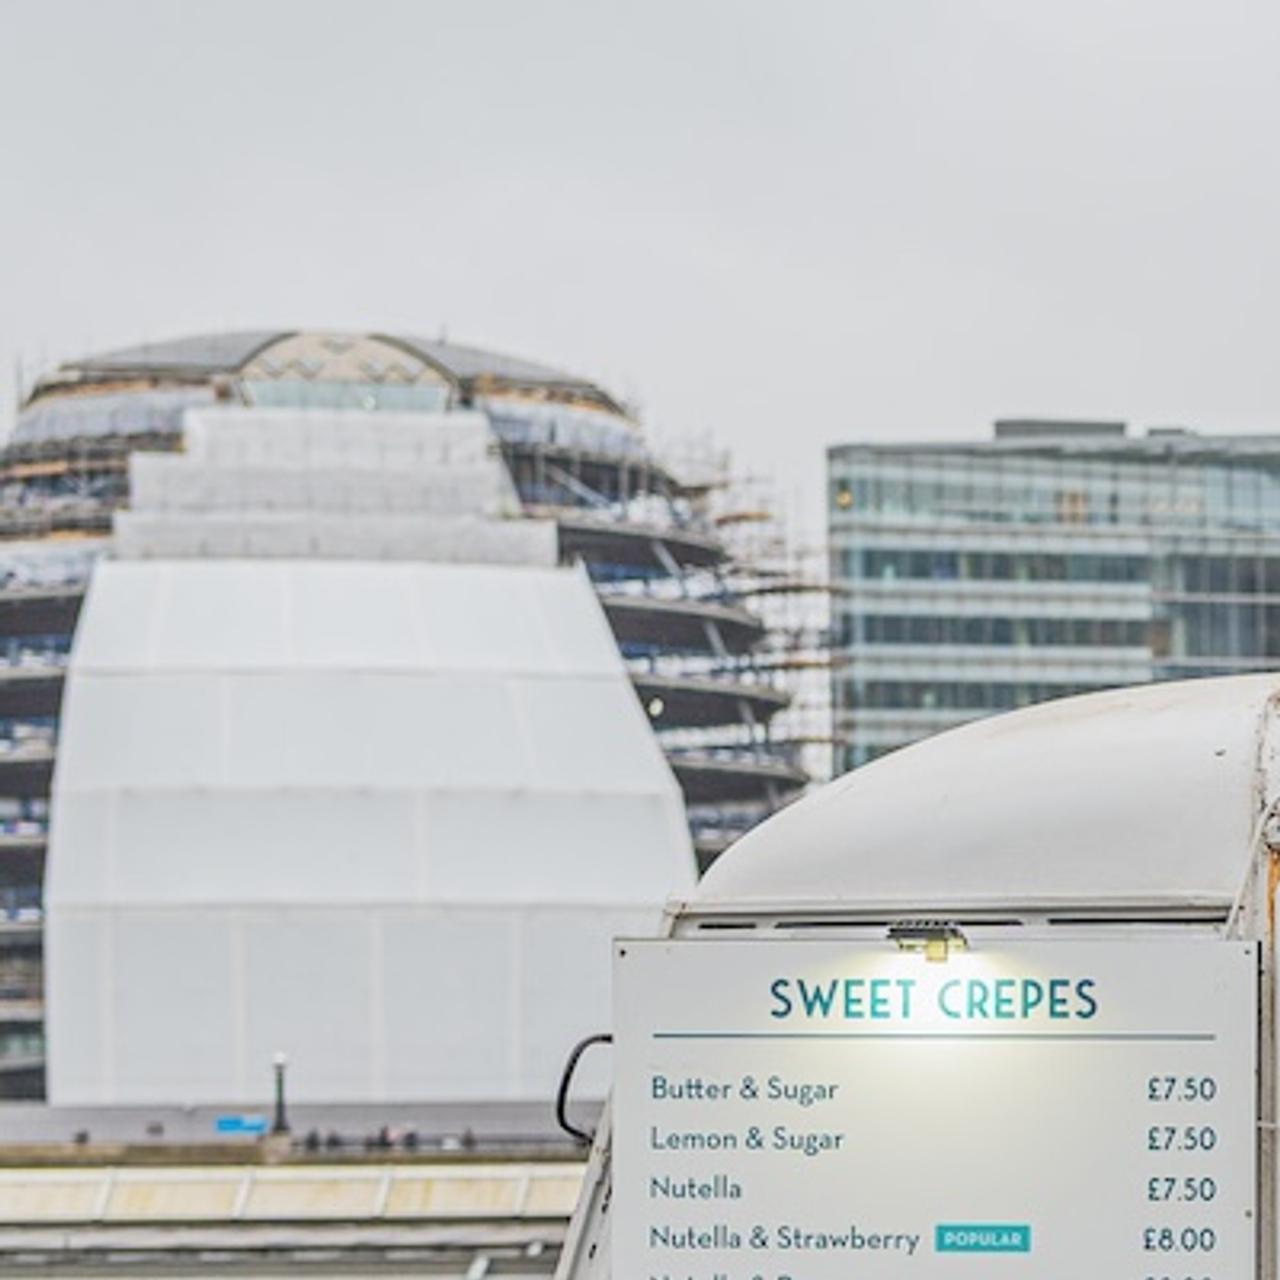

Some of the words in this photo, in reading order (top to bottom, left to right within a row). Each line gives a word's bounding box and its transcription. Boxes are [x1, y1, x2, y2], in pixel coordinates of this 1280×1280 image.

[769, 978, 914, 1020] SWEET
[938, 978, 1099, 1020] CREPES
[651, 1075, 732, 1100] Butter
[738, 1075, 759, 1101] &
[767, 1075, 839, 1106] Sugar
[1147, 1076, 1217, 1102] £7.50
[650, 1125, 738, 1150] Lemon
[744, 1126, 764, 1150] &
[772, 1125, 843, 1156] Sugar
[1147, 1126, 1217, 1151] £7.50
[649, 1174, 742, 1200] Nutella
[1147, 1176, 1217, 1202] £7.50
[649, 1224, 742, 1250] Nutella
[748, 1225, 769, 1250] &
[777, 1225, 921, 1256] Strawberry
[943, 1231, 1022, 1247] POPULAR
[1143, 1226, 1217, 1253] £8.00
